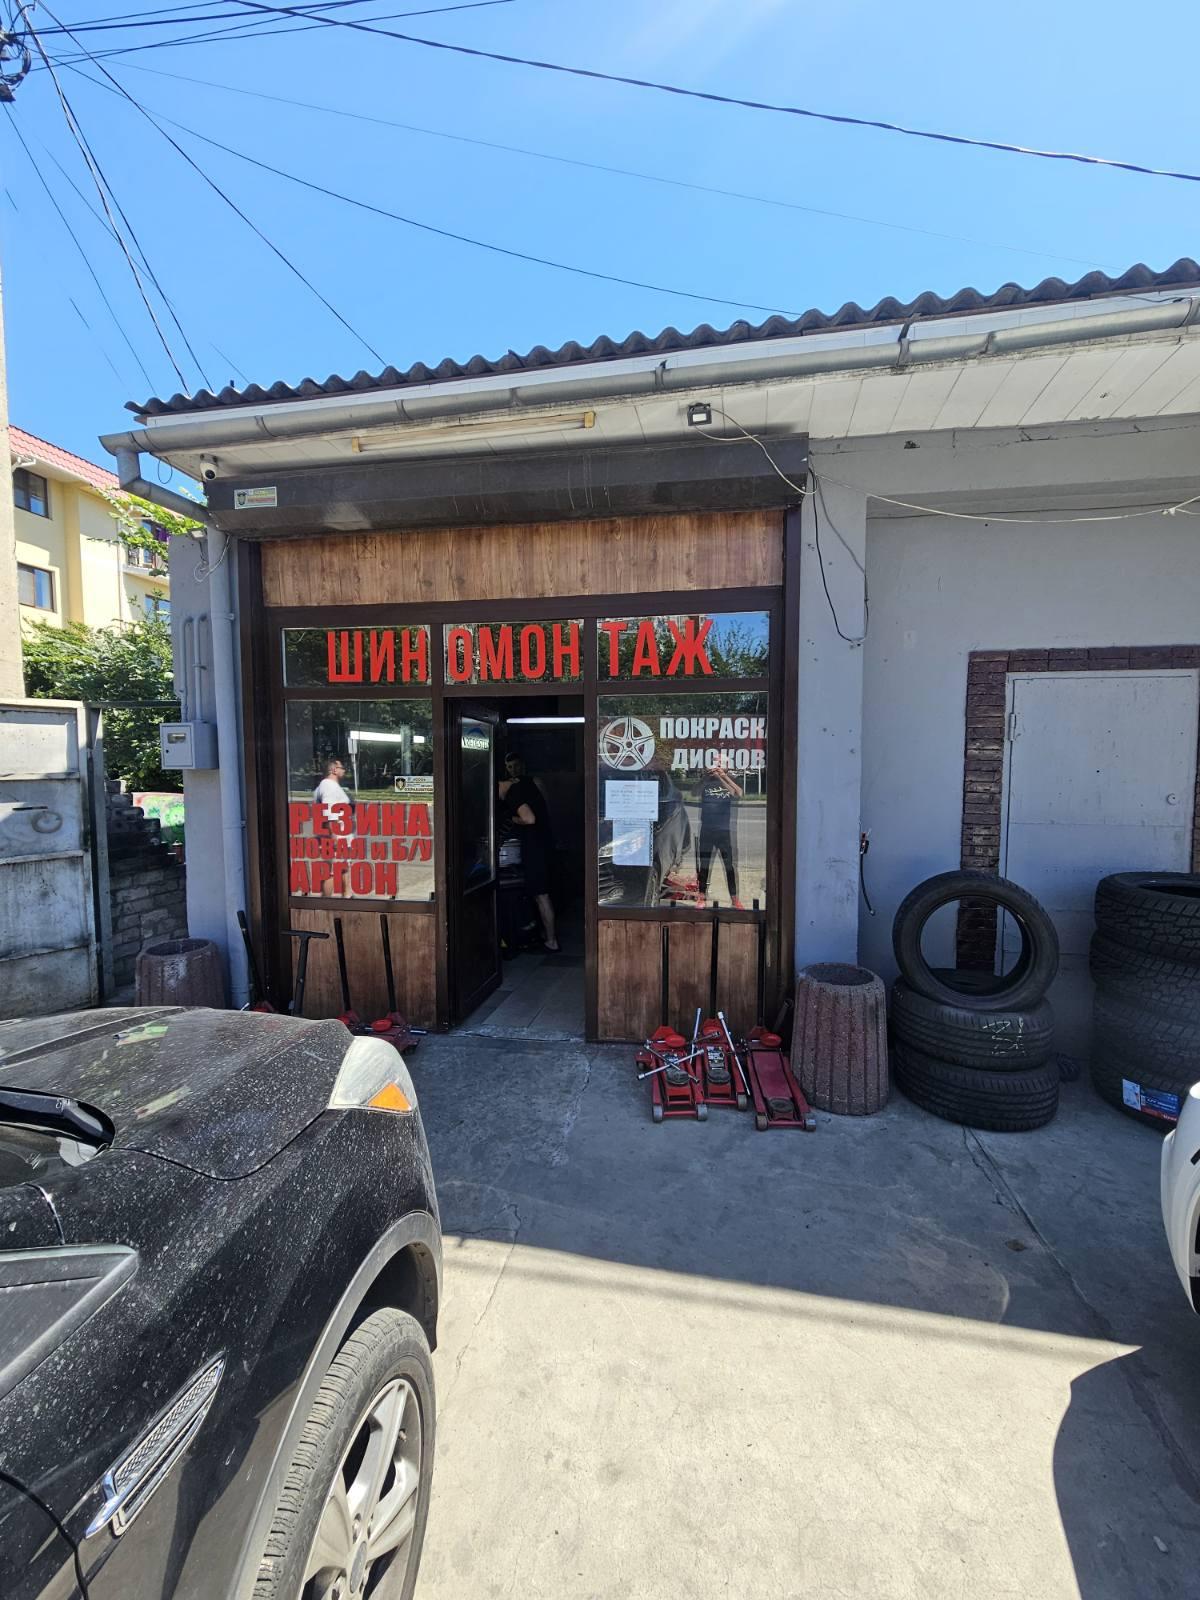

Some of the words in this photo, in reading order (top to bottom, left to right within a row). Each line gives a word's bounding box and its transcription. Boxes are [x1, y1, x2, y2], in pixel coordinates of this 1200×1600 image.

[659, 717, 768, 739] ПОКРАСК
[670, 748, 766, 771] ДИСКОВ
[289, 803, 432, 837] РЕЗИНА
[290, 837, 366, 861] НОВАЯ
[391, 837, 432, 862] Б/У
[290, 861, 398, 896] АРГОН
